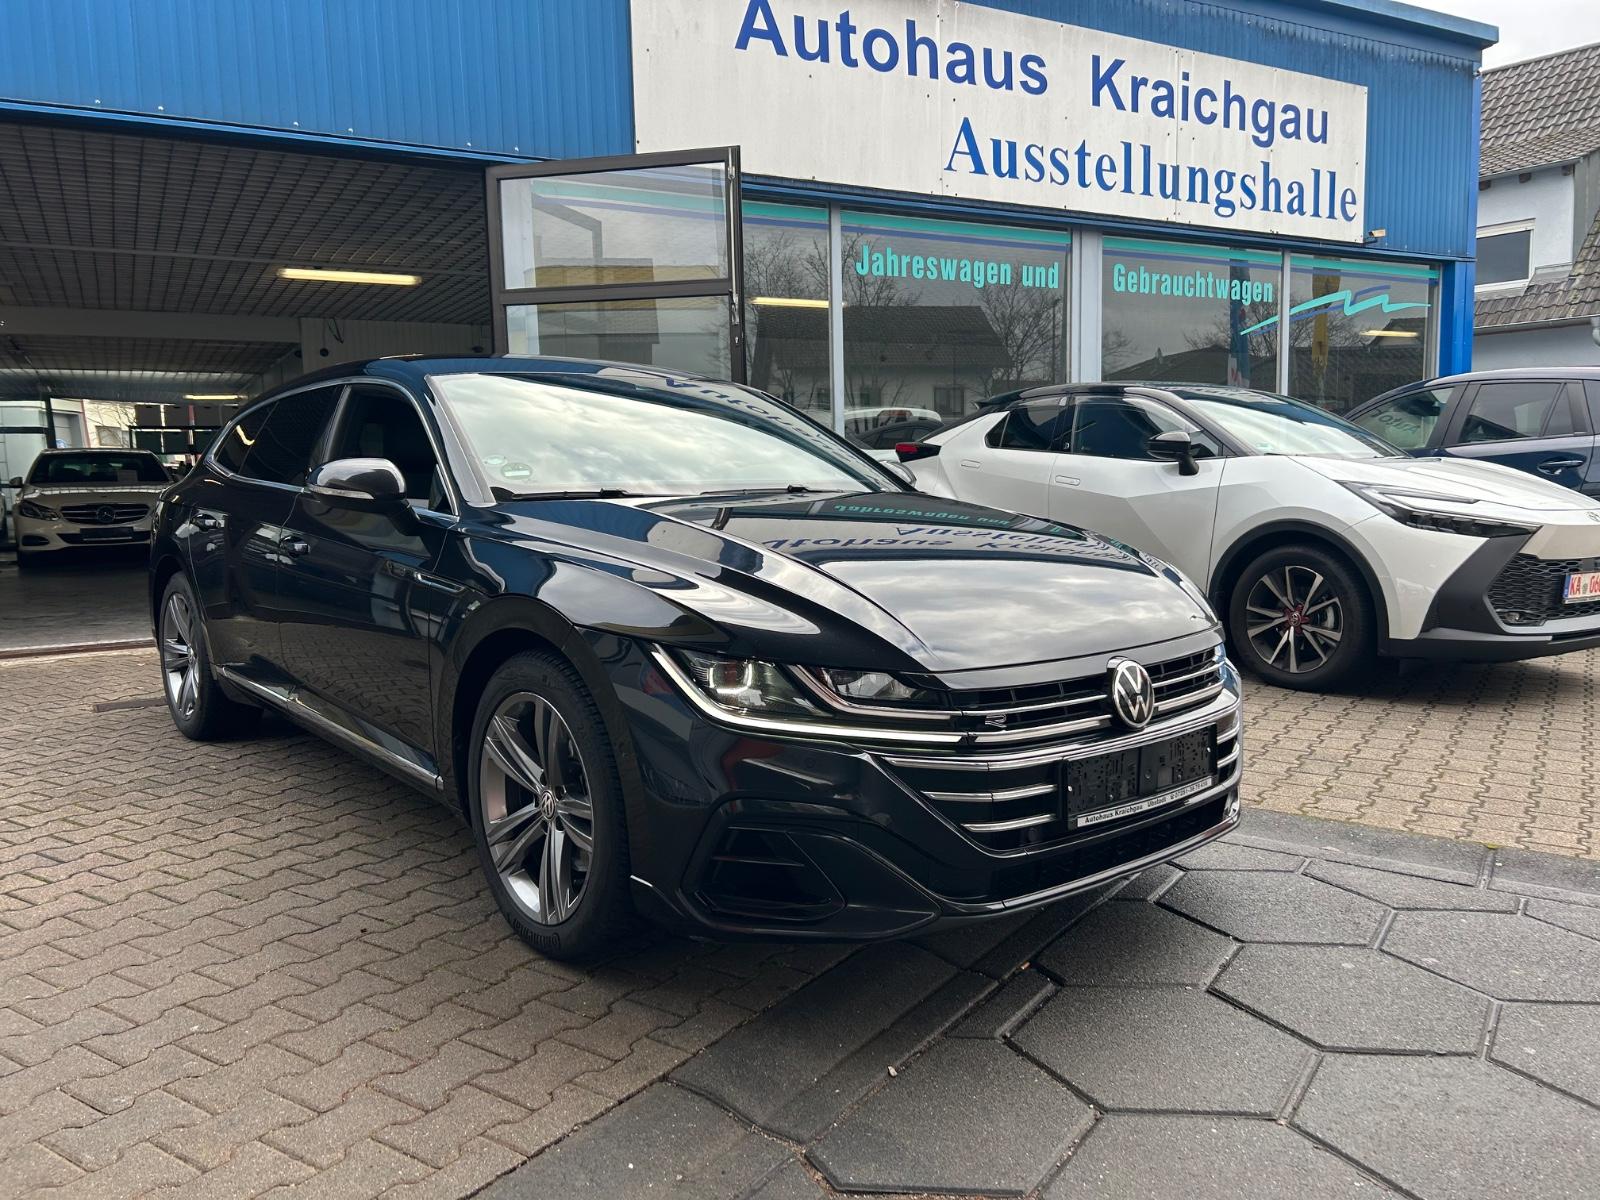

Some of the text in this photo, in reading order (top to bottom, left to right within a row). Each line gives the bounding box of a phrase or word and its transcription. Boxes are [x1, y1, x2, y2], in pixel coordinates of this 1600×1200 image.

[734, 0, 1329, 149] Autohaus Kraichgau
[945, 116, 1357, 222] Ausstellungshalle
[855, 244, 1060, 289] Jahreswagen und
[1113, 263, 1274, 305] Gebrauchtwagen
[1085, 811, 1114, 824] Autohaus
[1114, 805, 1143, 817] Kraichgau
